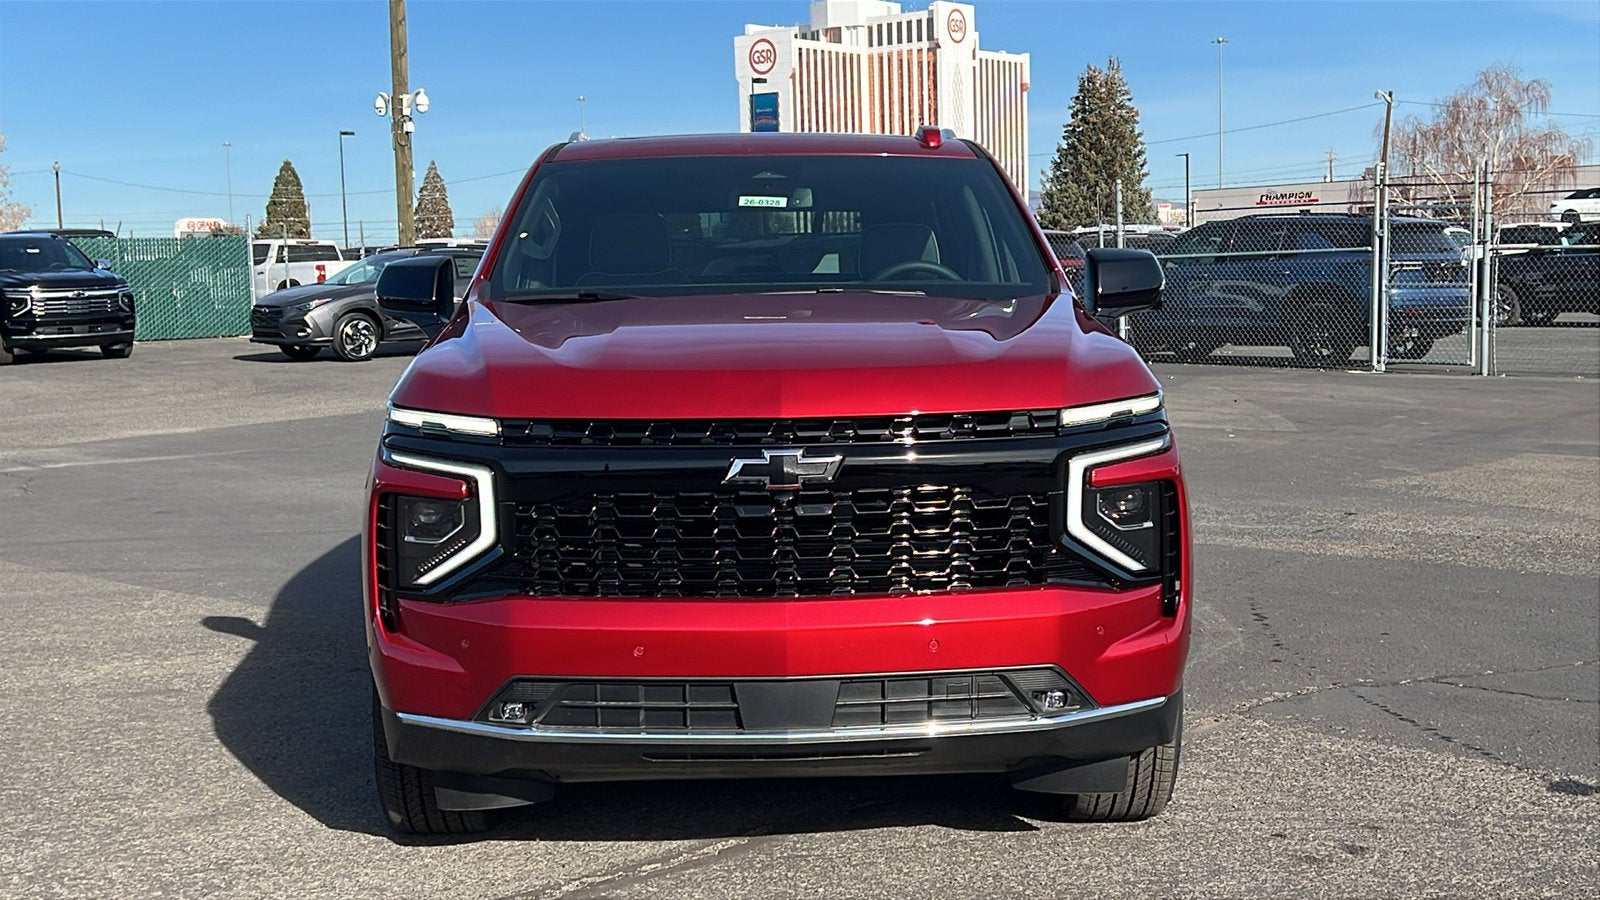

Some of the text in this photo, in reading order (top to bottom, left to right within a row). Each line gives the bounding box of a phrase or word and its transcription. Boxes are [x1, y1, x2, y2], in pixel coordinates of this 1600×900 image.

[950, 19, 964, 34] GSR
[752, 49, 773, 65] GSR
[1259, 191, 1313, 203] CHAMPION
